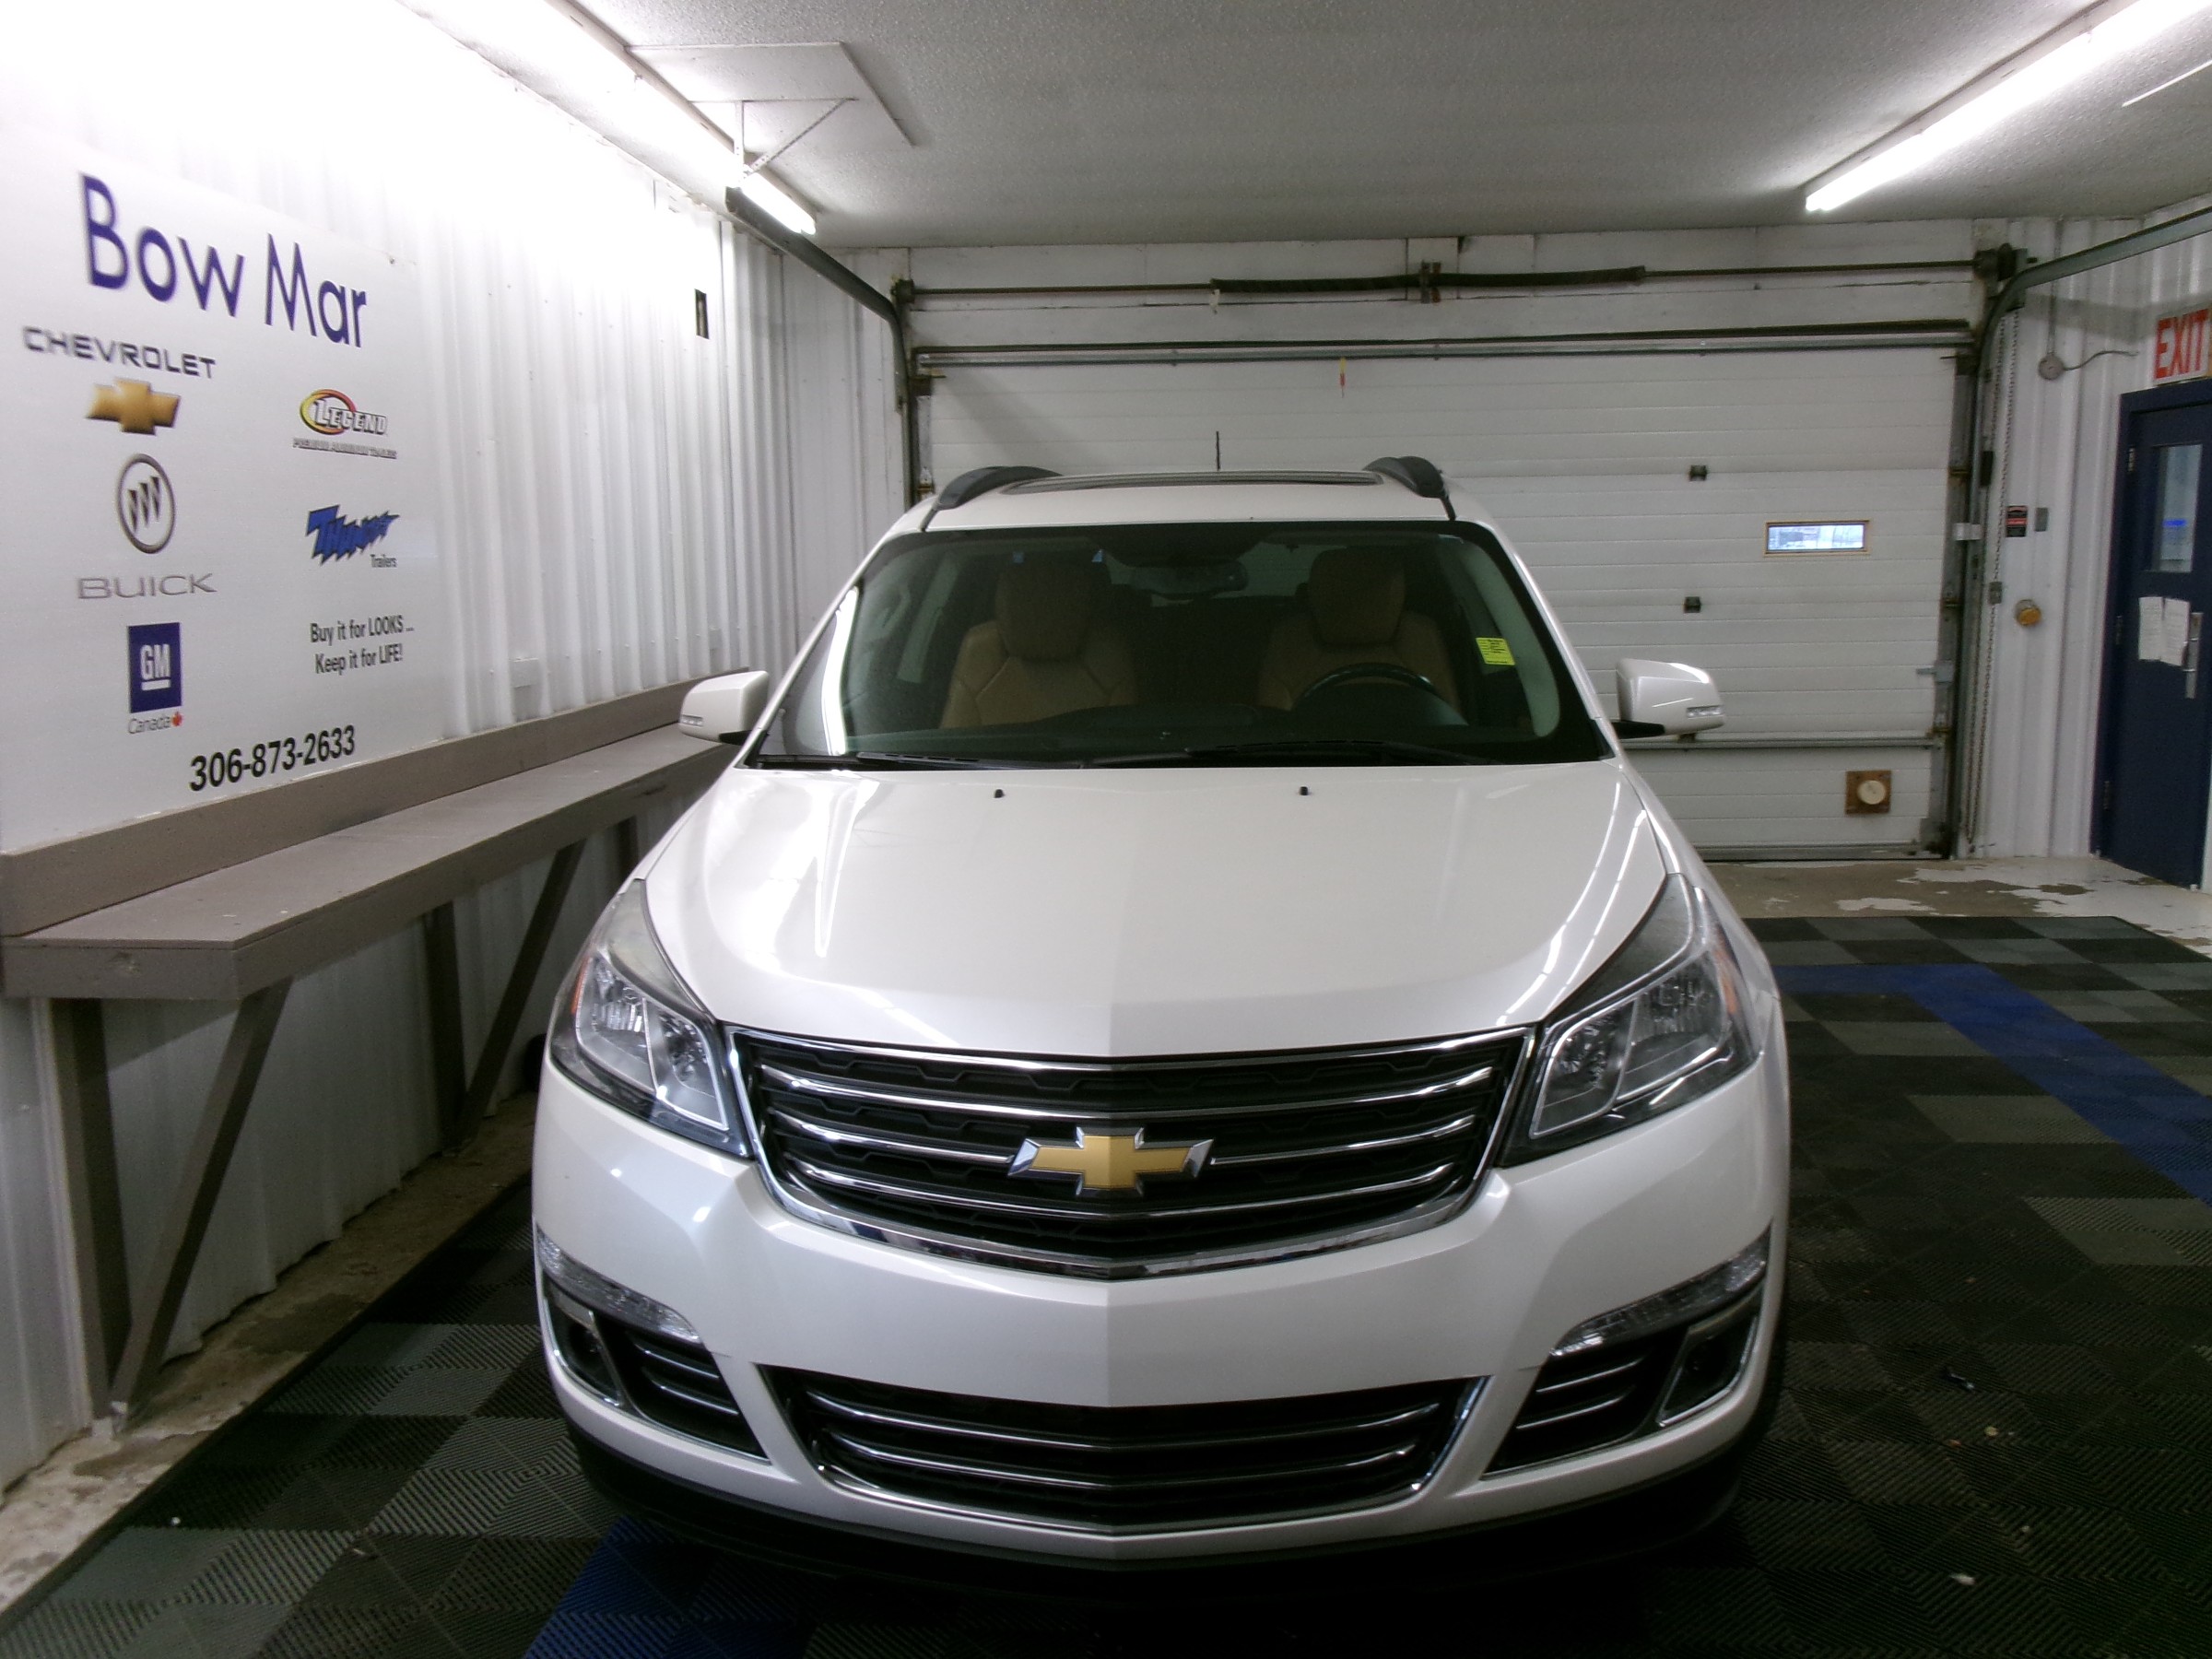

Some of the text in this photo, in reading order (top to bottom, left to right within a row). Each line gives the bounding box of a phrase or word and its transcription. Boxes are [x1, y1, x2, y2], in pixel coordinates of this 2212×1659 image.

[80, 172, 367, 347] Bow Mar
[22, 325, 216, 379] CHEVROLET
[2154, 309, 2209, 380] EXIT
[313, 398, 387, 435] LEGEND
[77, 572, 218, 599] BUICK
[310, 622, 334, 646] Buy
[337, 619, 347, 641] it
[349, 618, 366, 639] for
[140, 643, 171, 680] GM
[315, 642, 403, 676] Keep it for LIFE!
[129, 714, 171, 735] Canada
[189, 724, 356, 792] 306-873-2633
